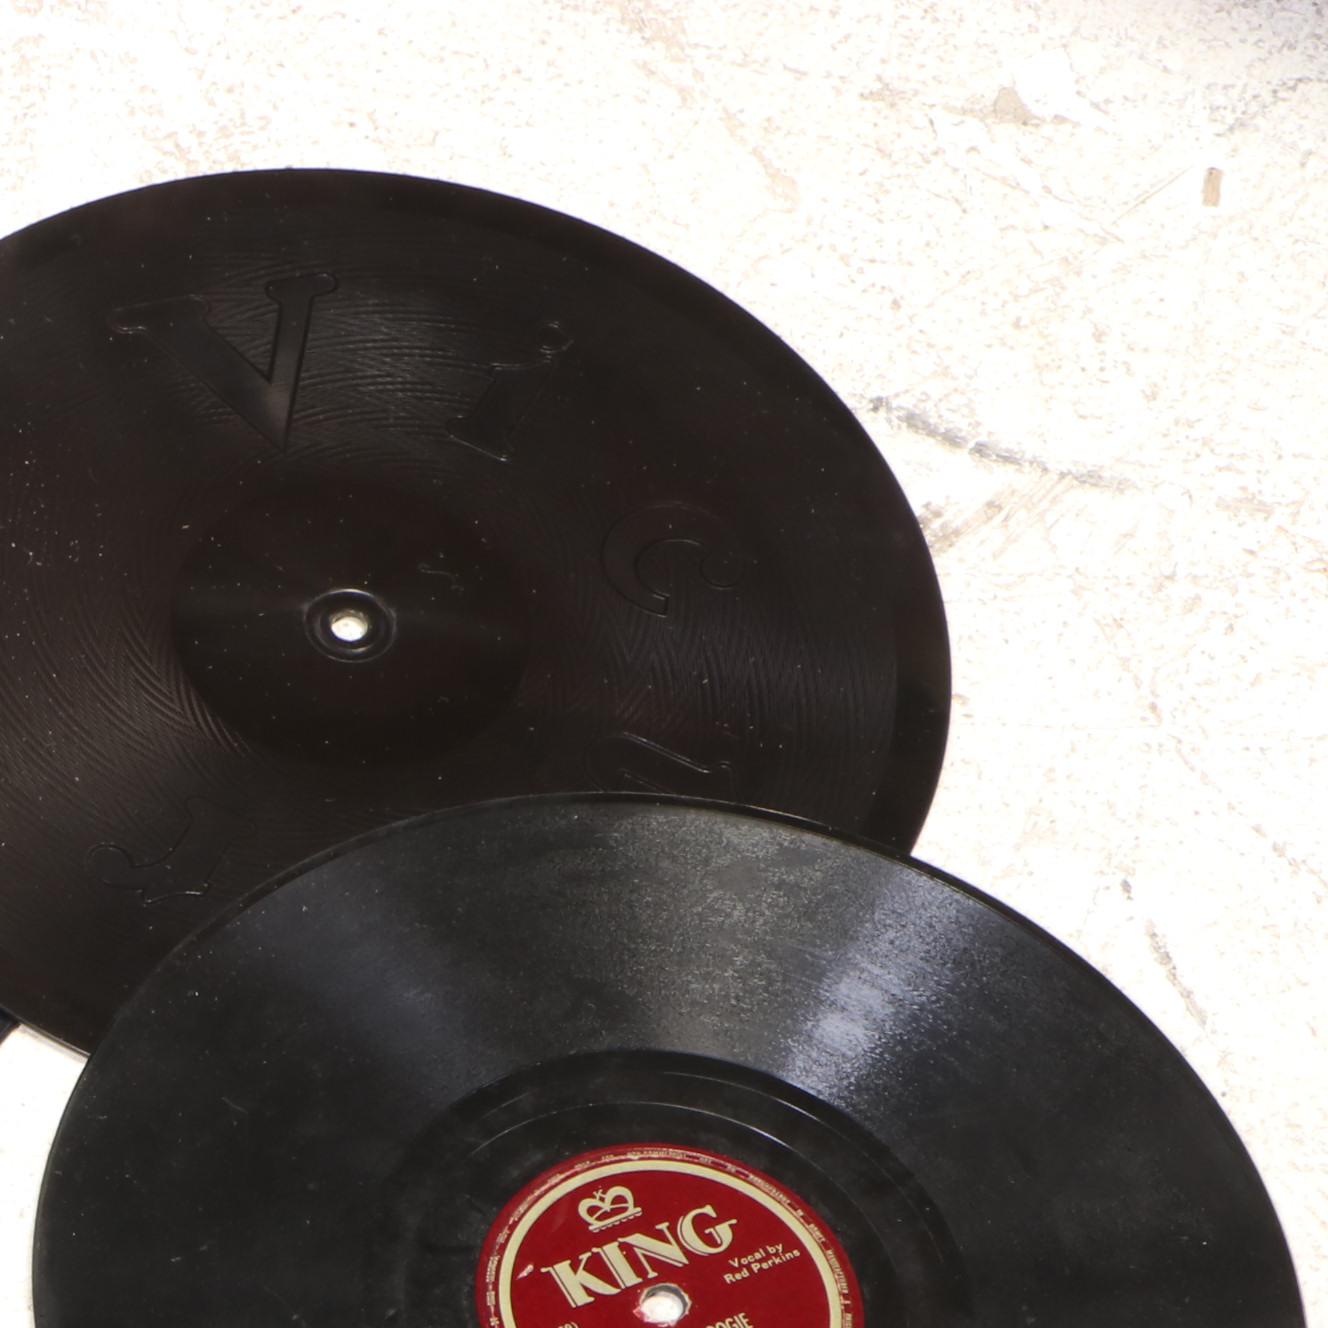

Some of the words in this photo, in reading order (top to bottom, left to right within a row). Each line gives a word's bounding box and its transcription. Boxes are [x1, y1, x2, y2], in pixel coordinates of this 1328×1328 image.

[540, 1205, 738, 1309] KING
[723, 1269, 749, 1285] Red
[751, 1248, 801, 1274] Perkins
[729, 1248, 765, 1268] Vocal
[767, 1244, 784, 1258] by
